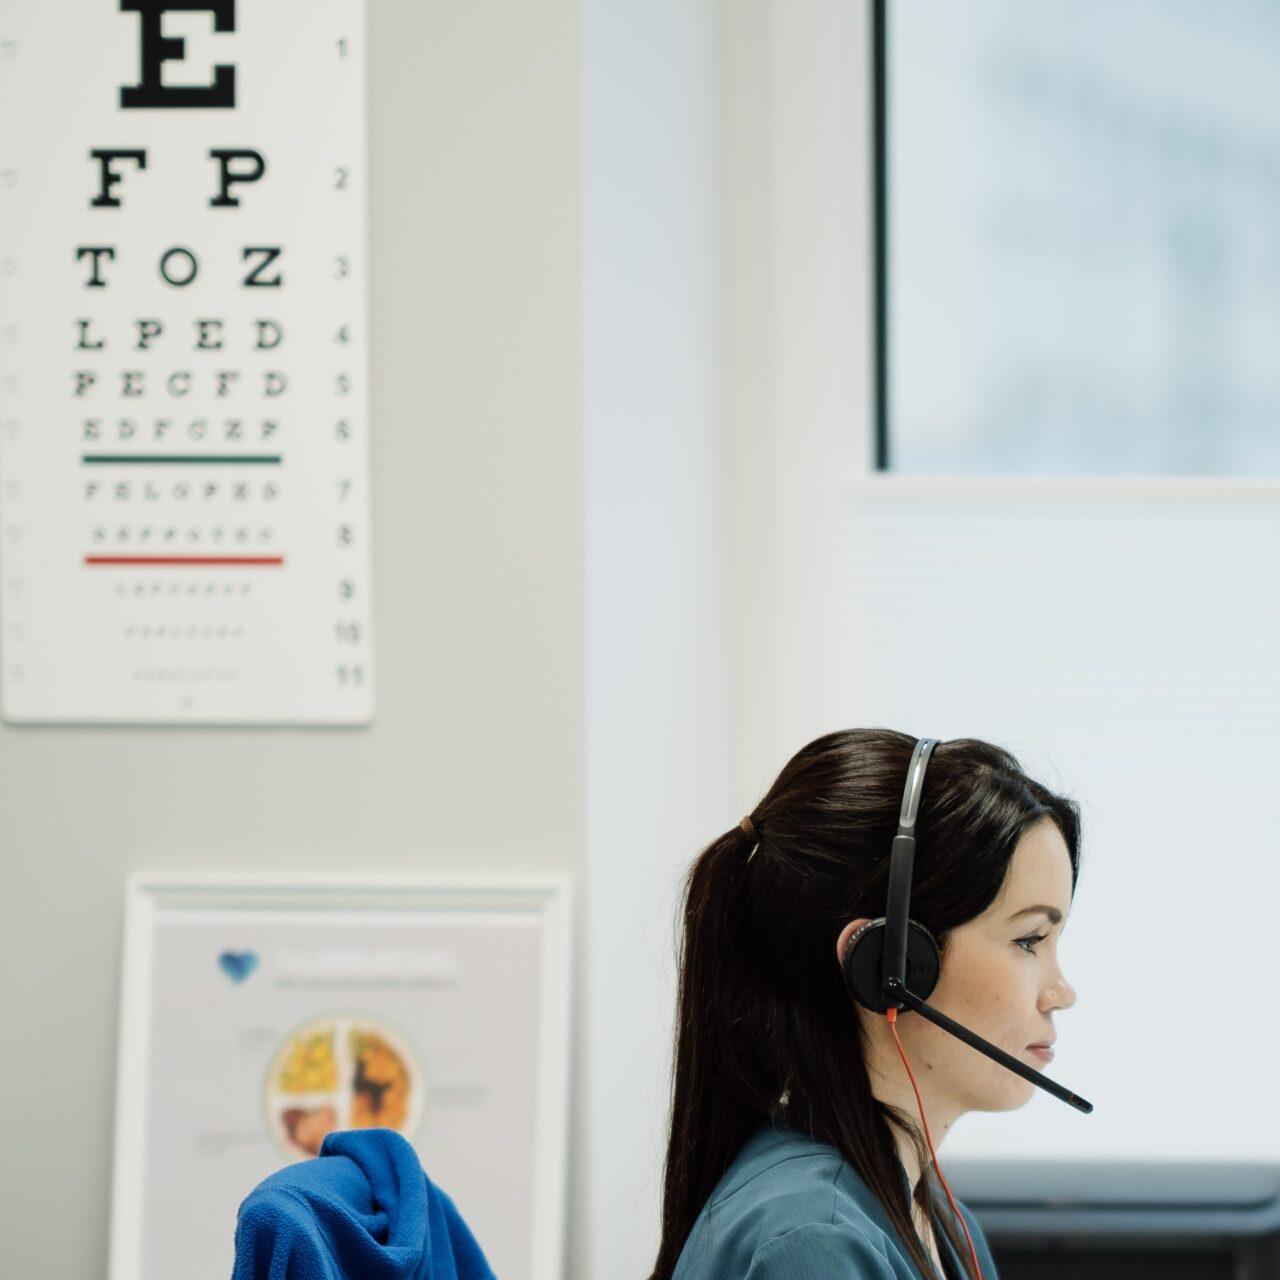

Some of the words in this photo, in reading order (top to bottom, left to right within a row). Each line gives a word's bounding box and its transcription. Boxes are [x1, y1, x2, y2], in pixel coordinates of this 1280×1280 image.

[119, 0, 236, 110] E
[90, 149, 147, 208] F
[209, 149, 266, 208] P
[333, 166, 351, 191] 2
[76, 247, 115, 288] T
[159, 247, 199, 288] O
[243, 247, 282, 287] Z
[334, 255, 351, 280] 3
[335, 325, 350, 346] 4
[335, 372, 352, 396] 5
[337, 478, 353, 502] 7
